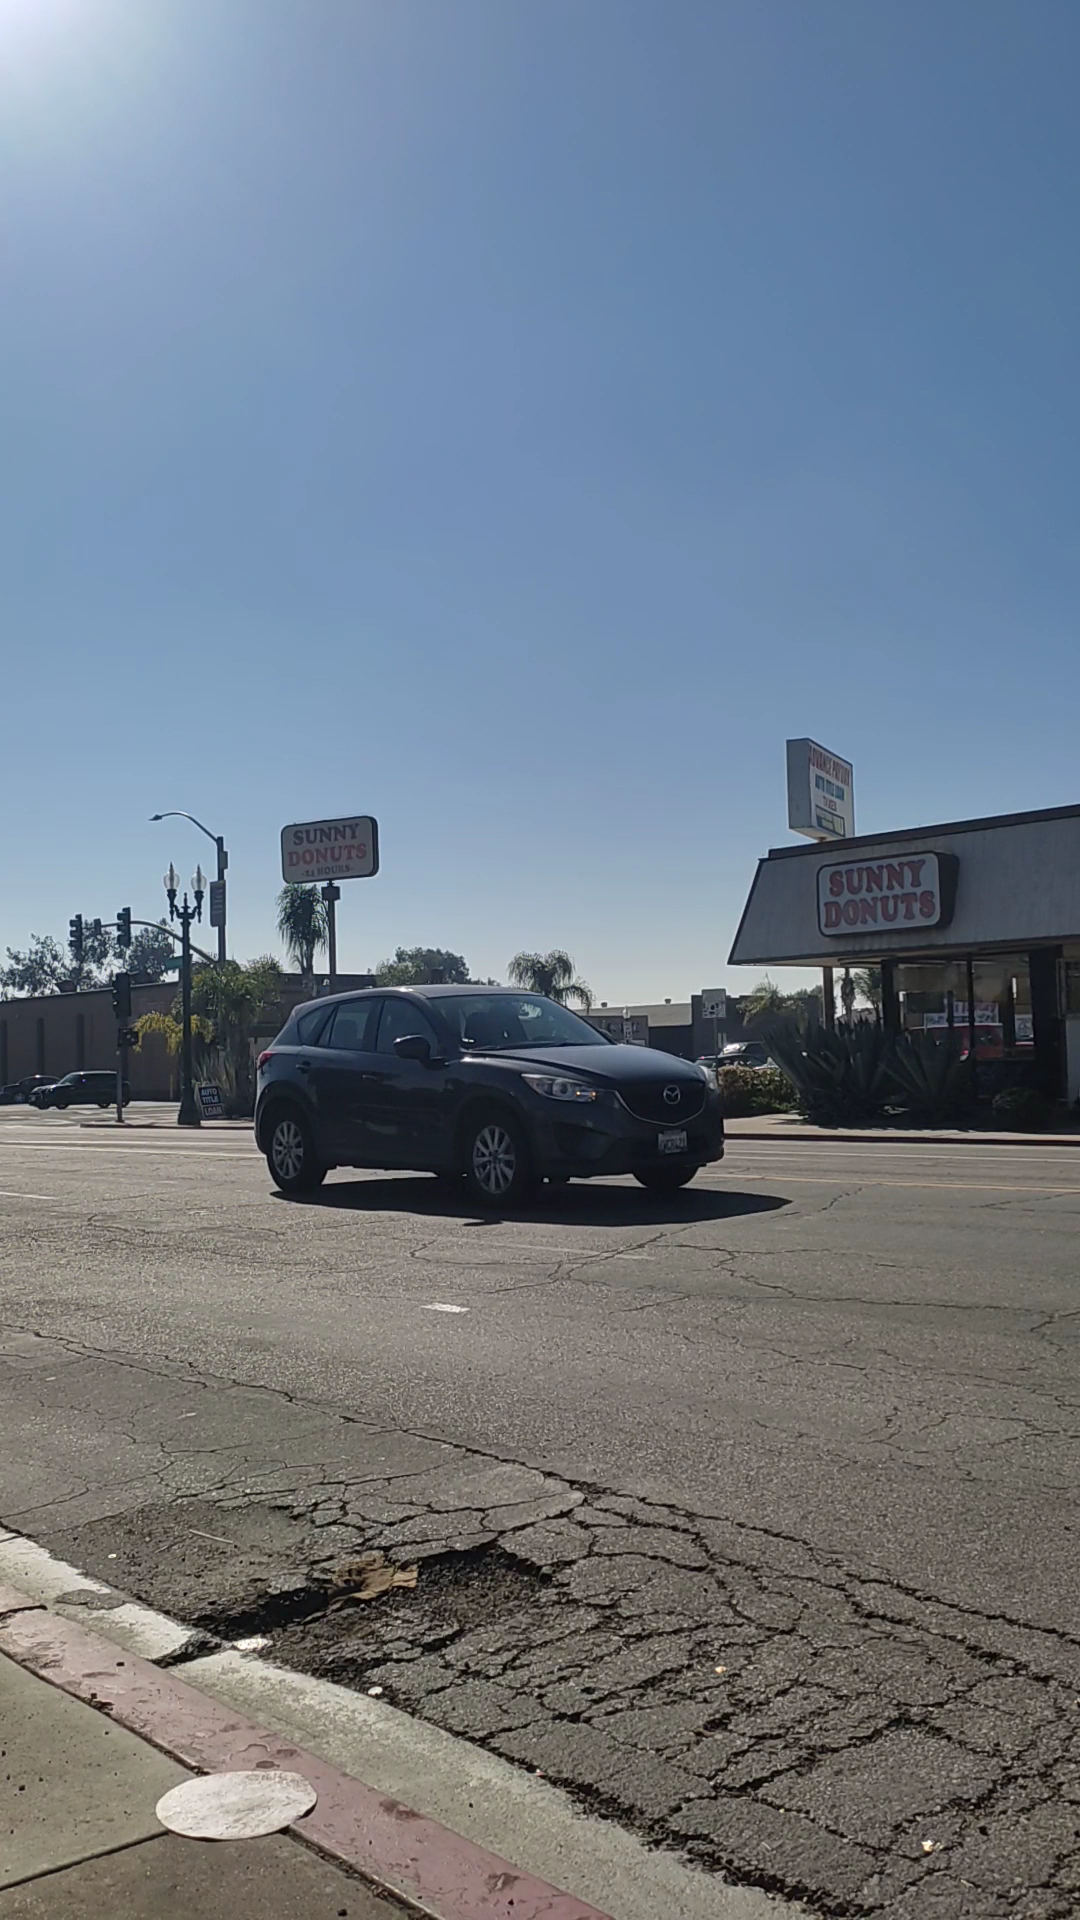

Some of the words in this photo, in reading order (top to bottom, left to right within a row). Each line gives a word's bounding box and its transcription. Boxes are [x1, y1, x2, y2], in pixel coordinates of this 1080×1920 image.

[293, 823, 360, 846] SUNNY
[288, 843, 367, 867] DONUTS
[829, 860, 926, 897] SUNNY
[824, 890, 935, 928] DONUTS
[201, 1088, 217, 1096] AUTO
[202, 1095, 219, 1104] TITLE
[204, 1106, 222, 1115] LOAN
